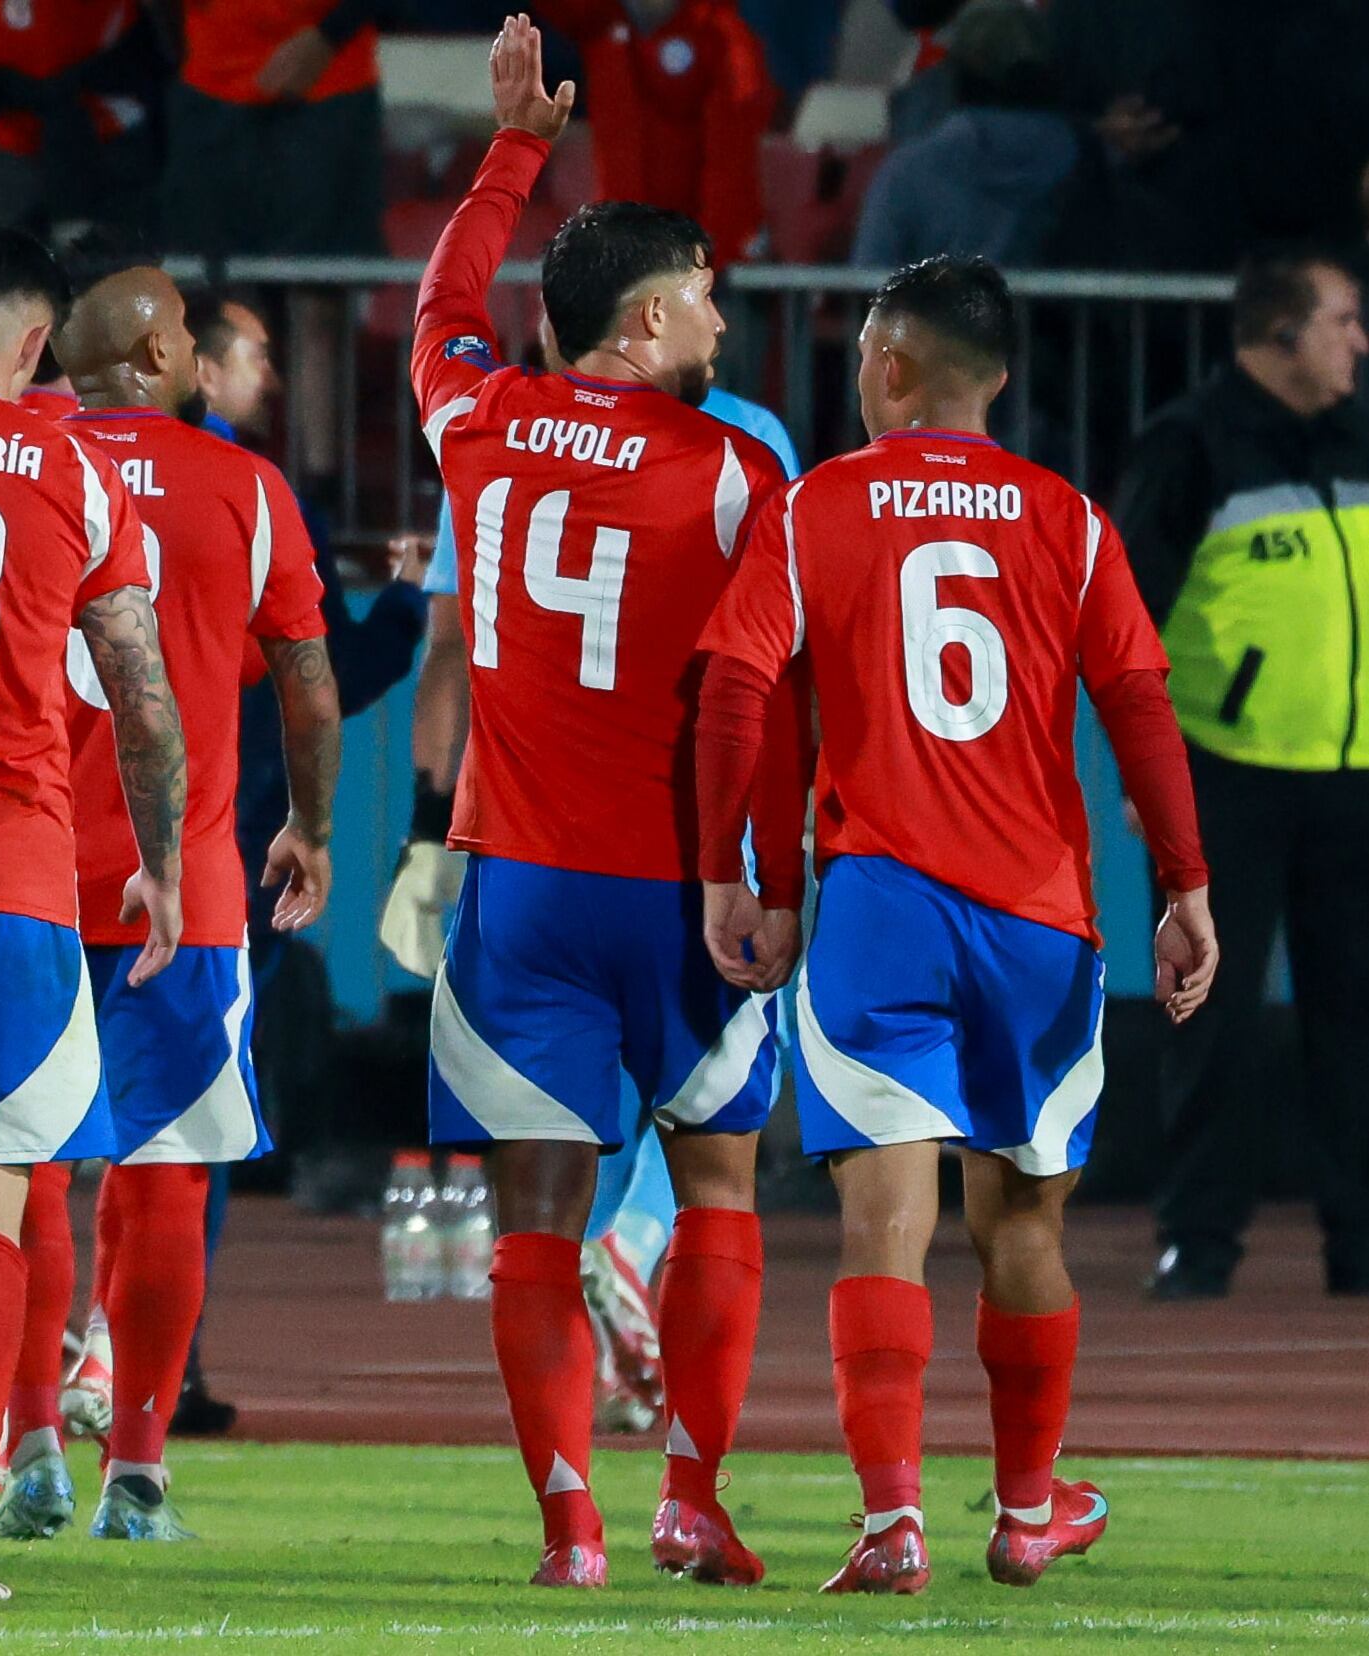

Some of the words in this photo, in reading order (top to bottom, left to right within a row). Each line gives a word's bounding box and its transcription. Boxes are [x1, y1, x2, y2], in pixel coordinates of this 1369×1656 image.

[505, 417, 647, 471] LOYOLA
[869, 479, 1022, 521] PIZARRO
[472, 477, 631, 691] 14
[899, 540, 1008, 742] 6
